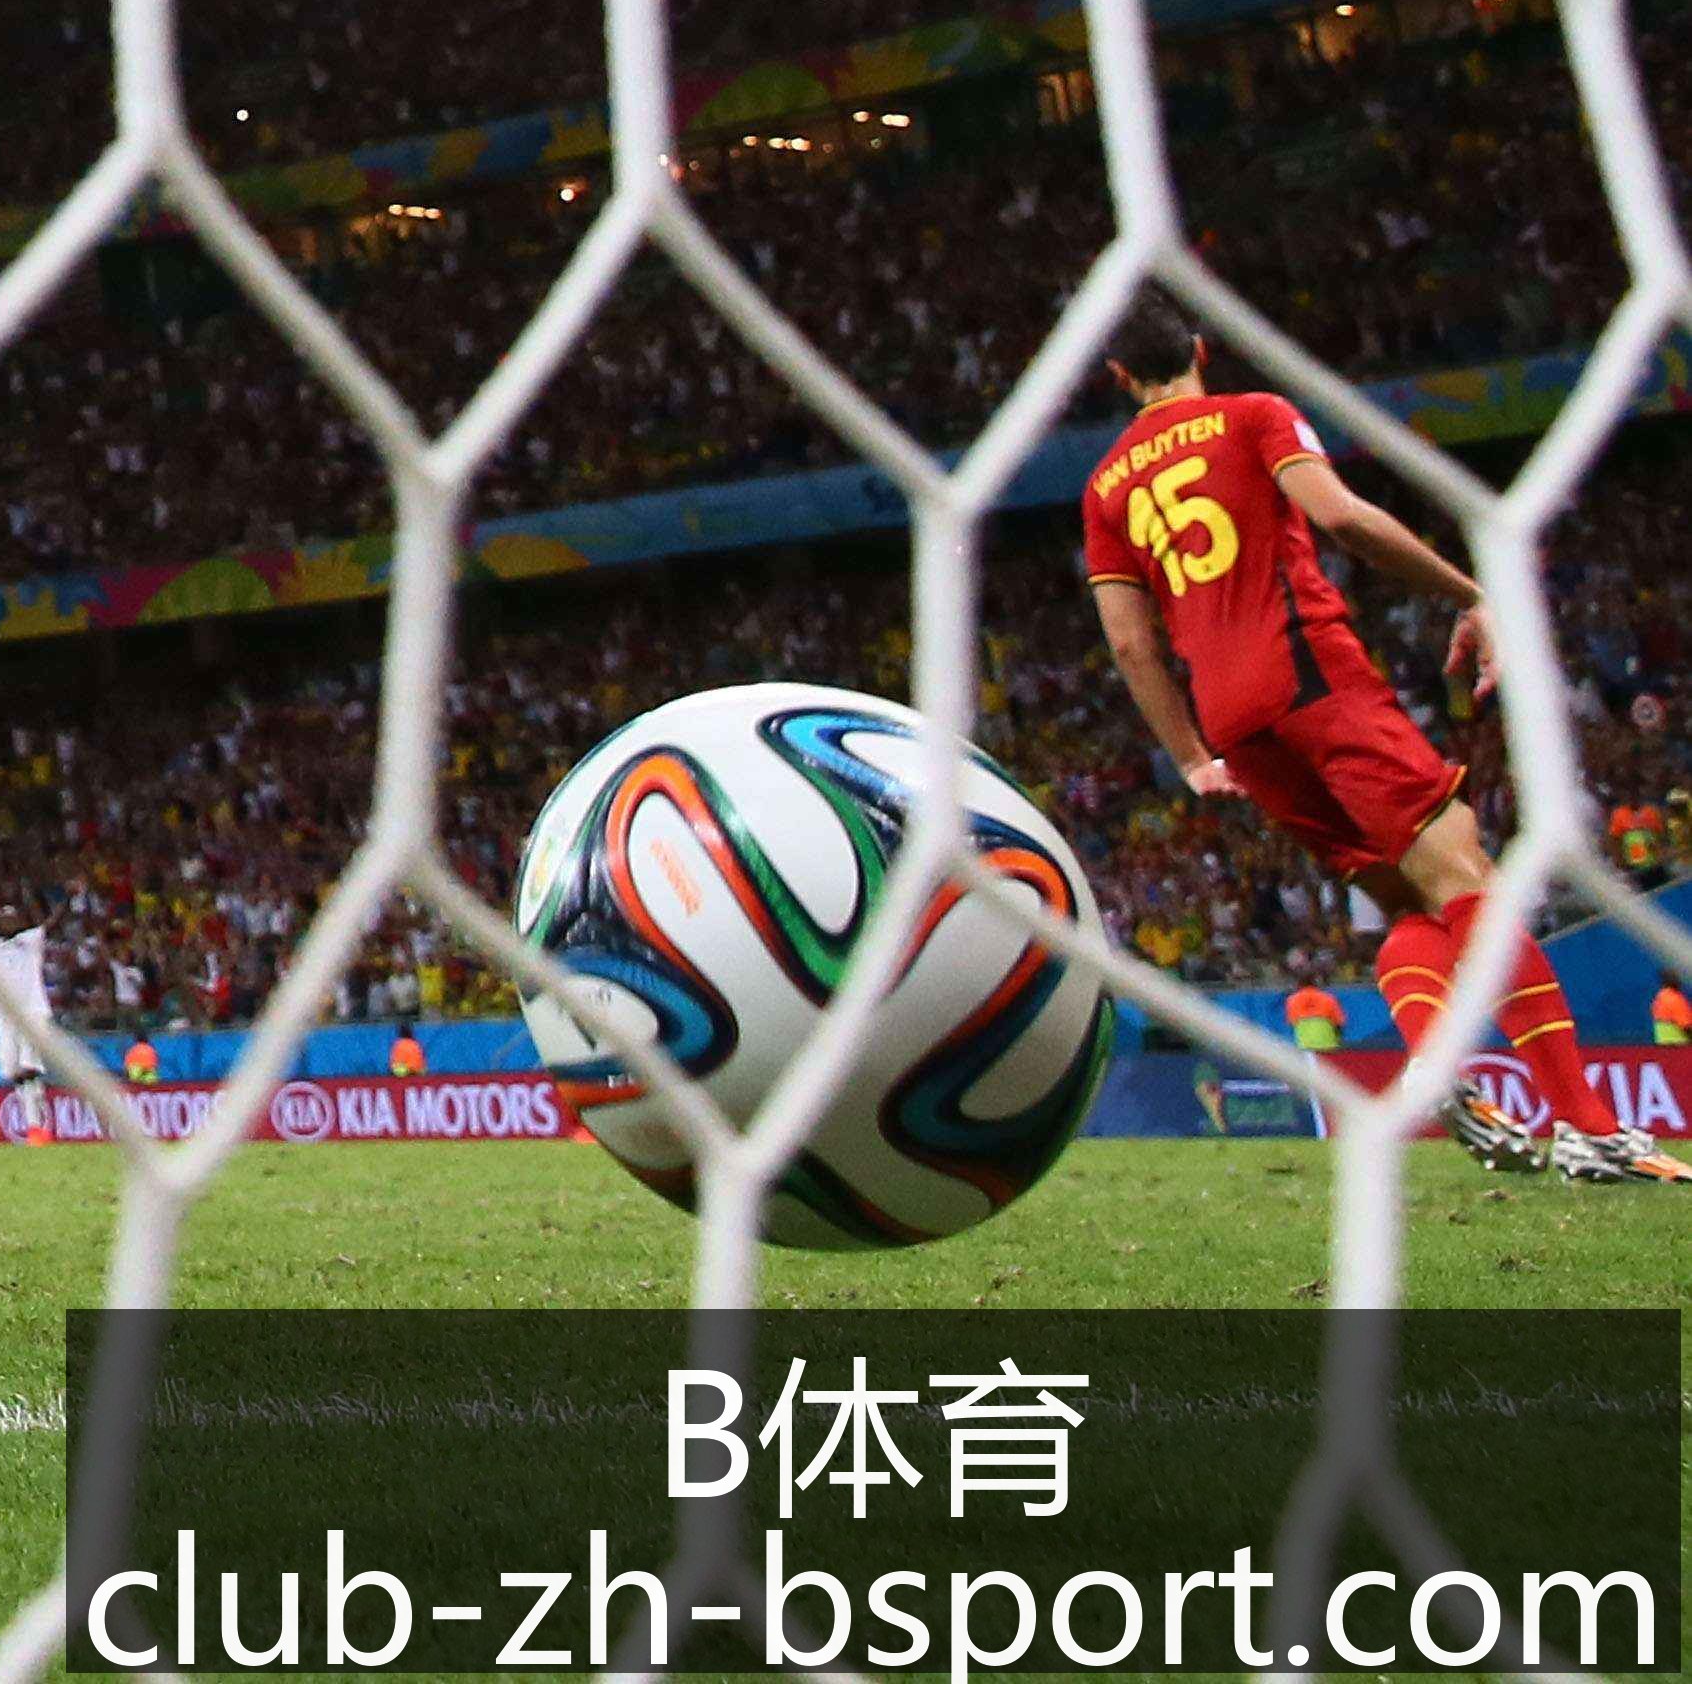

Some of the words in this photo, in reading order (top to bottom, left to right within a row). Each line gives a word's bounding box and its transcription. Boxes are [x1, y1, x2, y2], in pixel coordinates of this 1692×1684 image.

[1129, 411, 1226, 472] BUYTEN
[1128, 455, 1239, 597] 15
[337, 1086, 399, 1136] KIA
[405, 1081, 559, 1137] MOTORS
